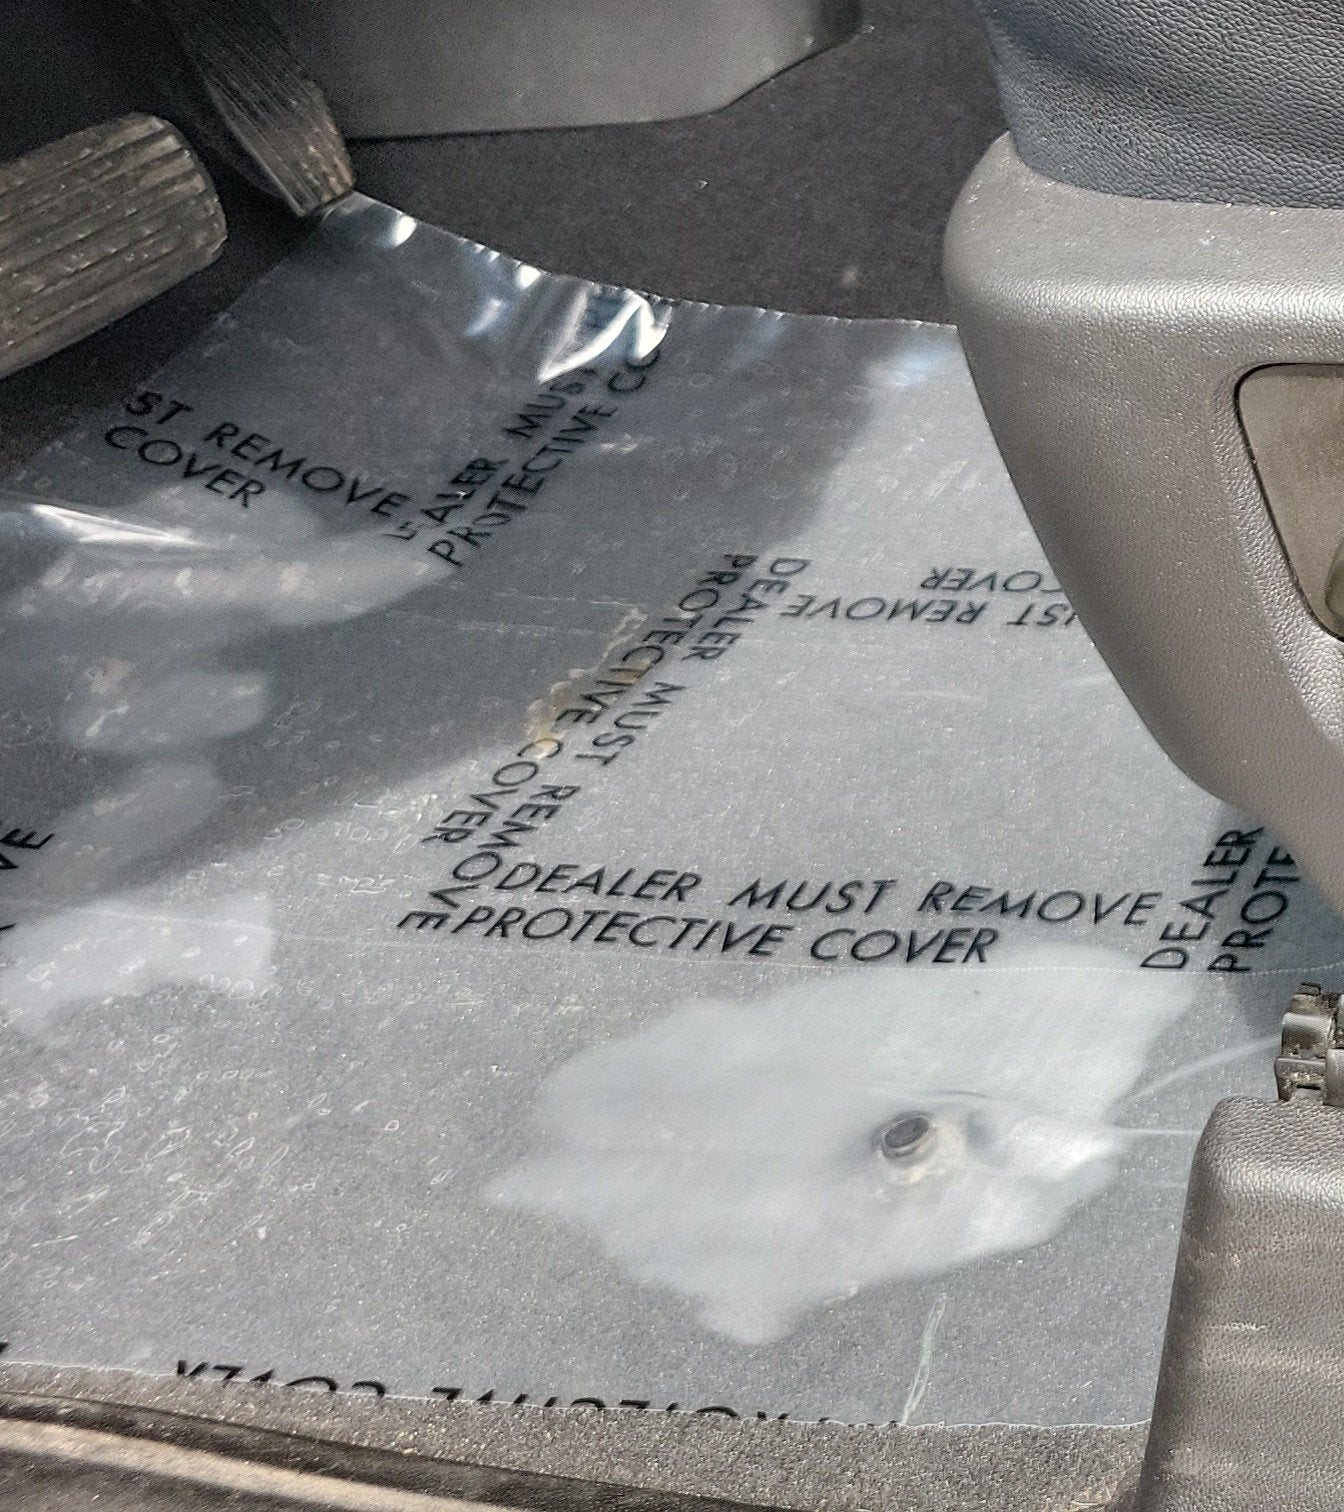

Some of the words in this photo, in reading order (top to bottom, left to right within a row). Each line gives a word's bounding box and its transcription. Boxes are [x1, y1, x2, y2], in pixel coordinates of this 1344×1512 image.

[104, 425, 267, 509] COVER
[204, 421, 412, 518] REMOVE
[427, 403, 619, 568] PROTECTIVE
[681, 556, 812, 662] DEALER
[779, 593, 988, 625] REMOVE
[919, 566, 1065, 594] OVER
[555, 553, 759, 727] PROTECTIVE
[574, 681, 687, 767] MUST
[421, 737, 565, 844] COVER
[396, 784, 583, 931] REMOVE
[494, 861, 703, 902] DEALER
[727, 877, 898, 915] MUST
[916, 881, 1163, 926] REMOVE
[1139, 826, 1265, 970] DEALER
[450, 904, 795, 957] PROTECTIVE
[809, 927, 1001, 965] COVER
